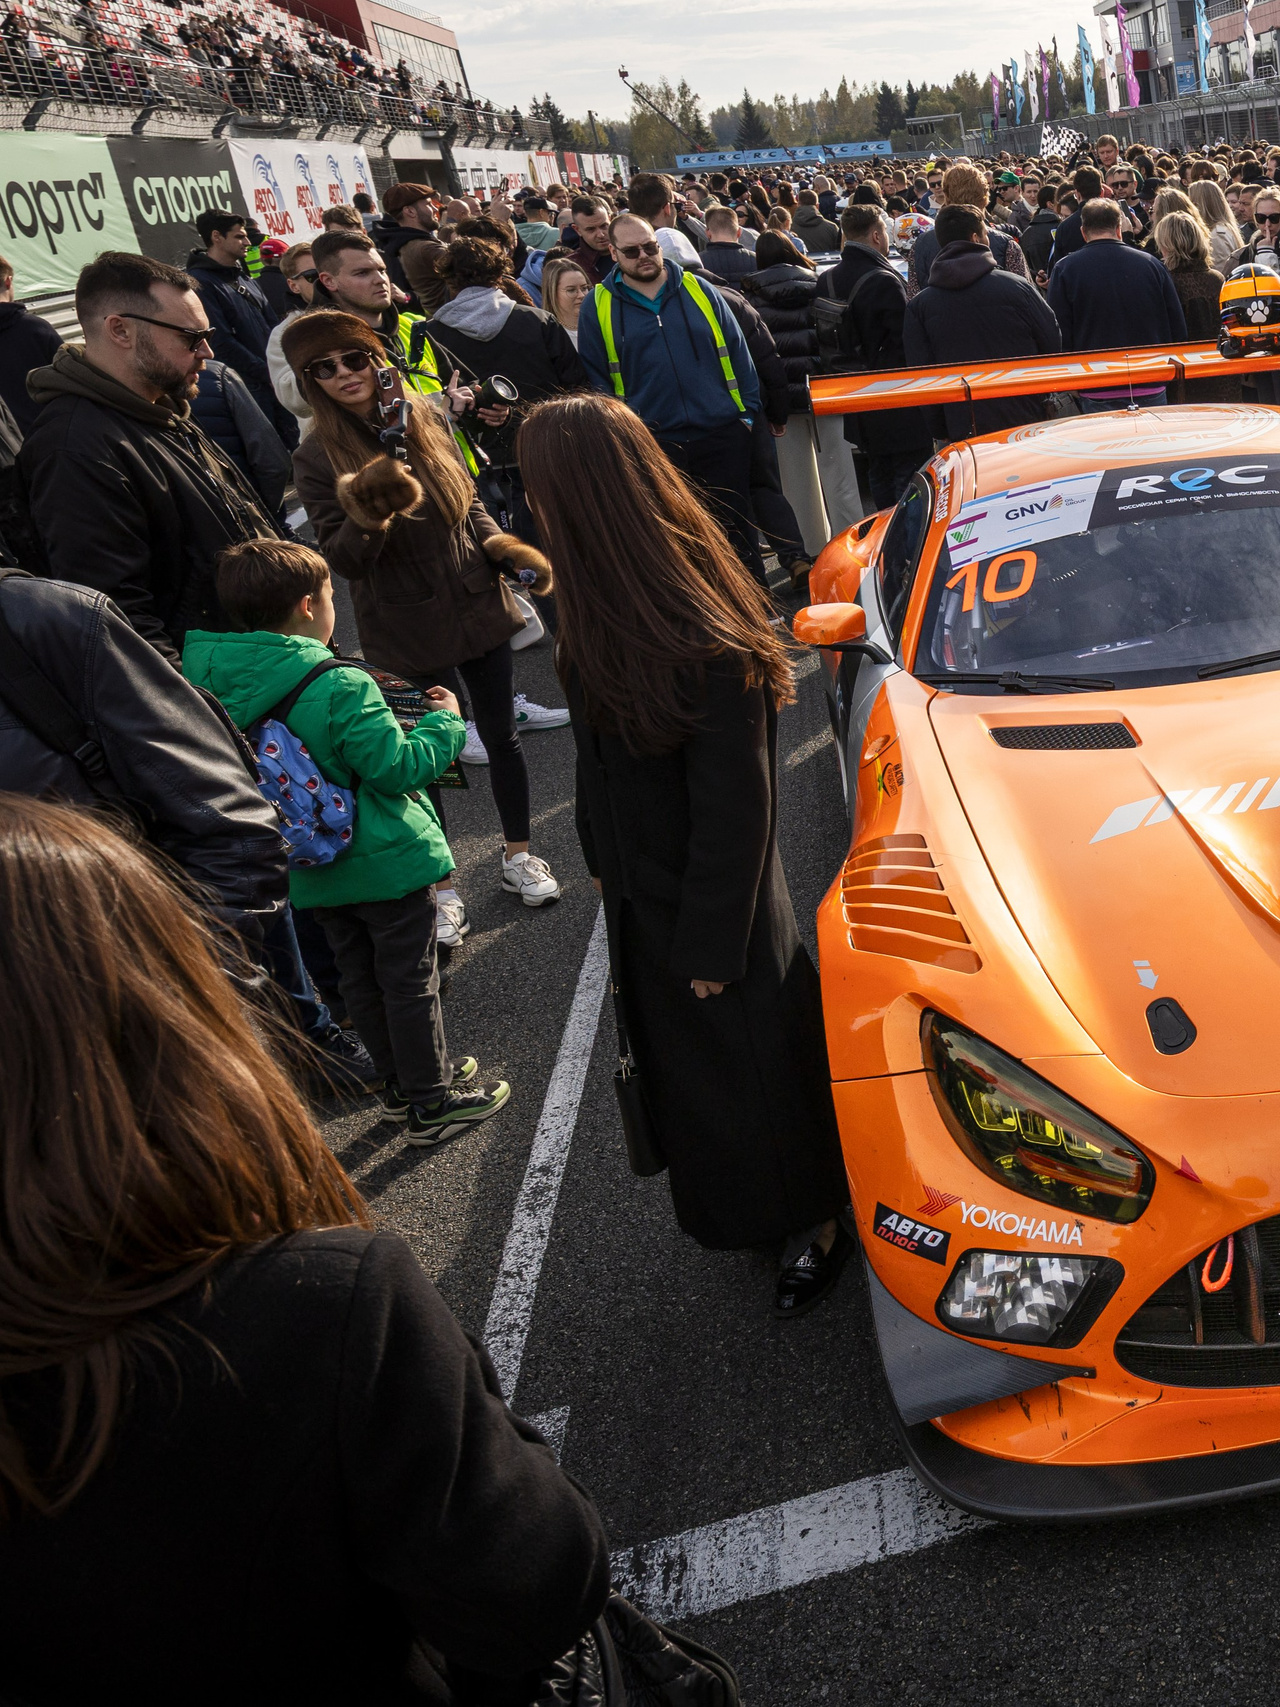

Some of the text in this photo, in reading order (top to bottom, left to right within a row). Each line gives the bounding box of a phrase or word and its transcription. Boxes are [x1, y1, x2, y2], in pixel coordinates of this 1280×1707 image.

[253, 187, 277, 213] АВТО
[263, 210, 295, 237] РАДИО
[1005, 500, 1049, 521] GNV
[1118, 500, 1163, 511] РОССИЙСКАЯ
[1165, 496, 1187, 504] СЕРИЯ
[1226, 489, 1280, 498] ВЫНОСЛИВОСТЬ
[945, 550, 1038, 613] 10
[881, 1213, 944, 1248] АВТО
[960, 1201, 1083, 1247] YOKOHAMA
[876, 1226, 919, 1251] ПЛЮС
